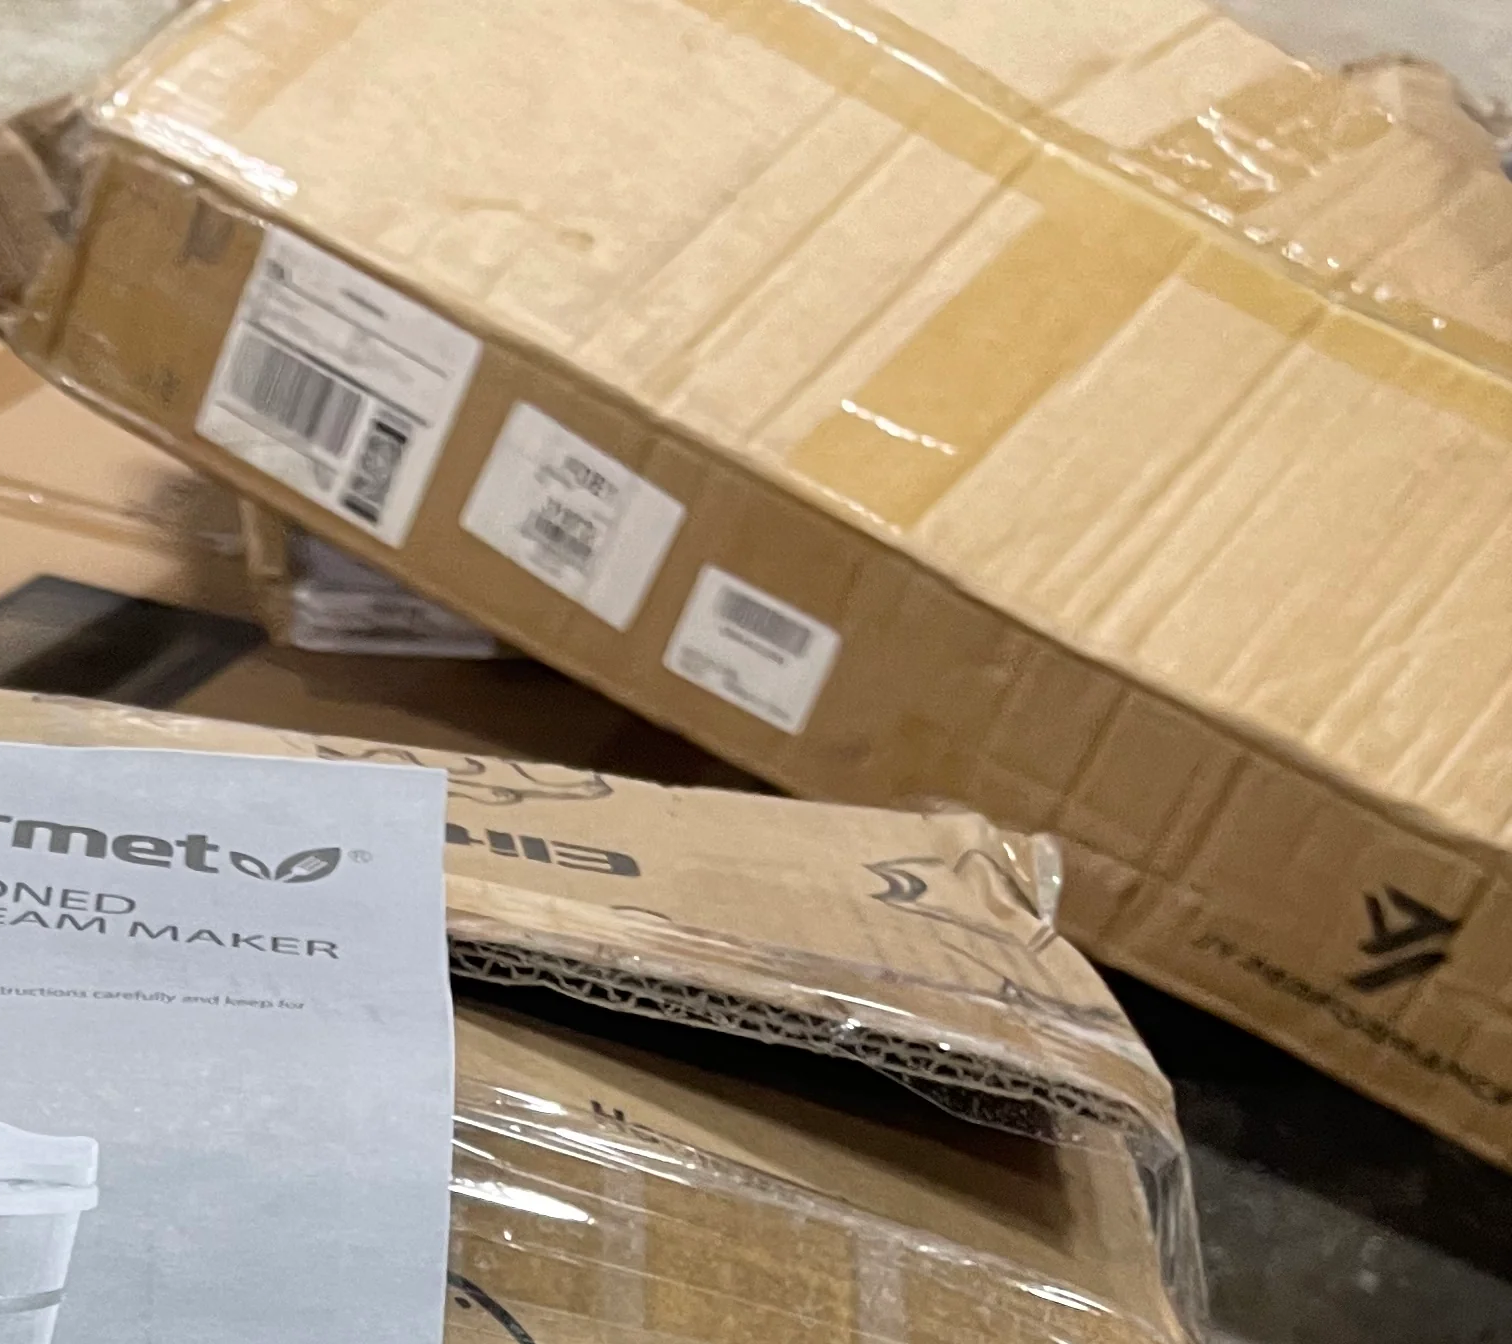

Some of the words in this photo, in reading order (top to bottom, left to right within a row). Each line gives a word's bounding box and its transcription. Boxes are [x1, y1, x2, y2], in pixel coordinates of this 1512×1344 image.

[128, 921, 340, 959] MAKER
[92, 988, 177, 1005] carefully
[181, 993, 220, 1007] and
[223, 996, 274, 1011] keep
